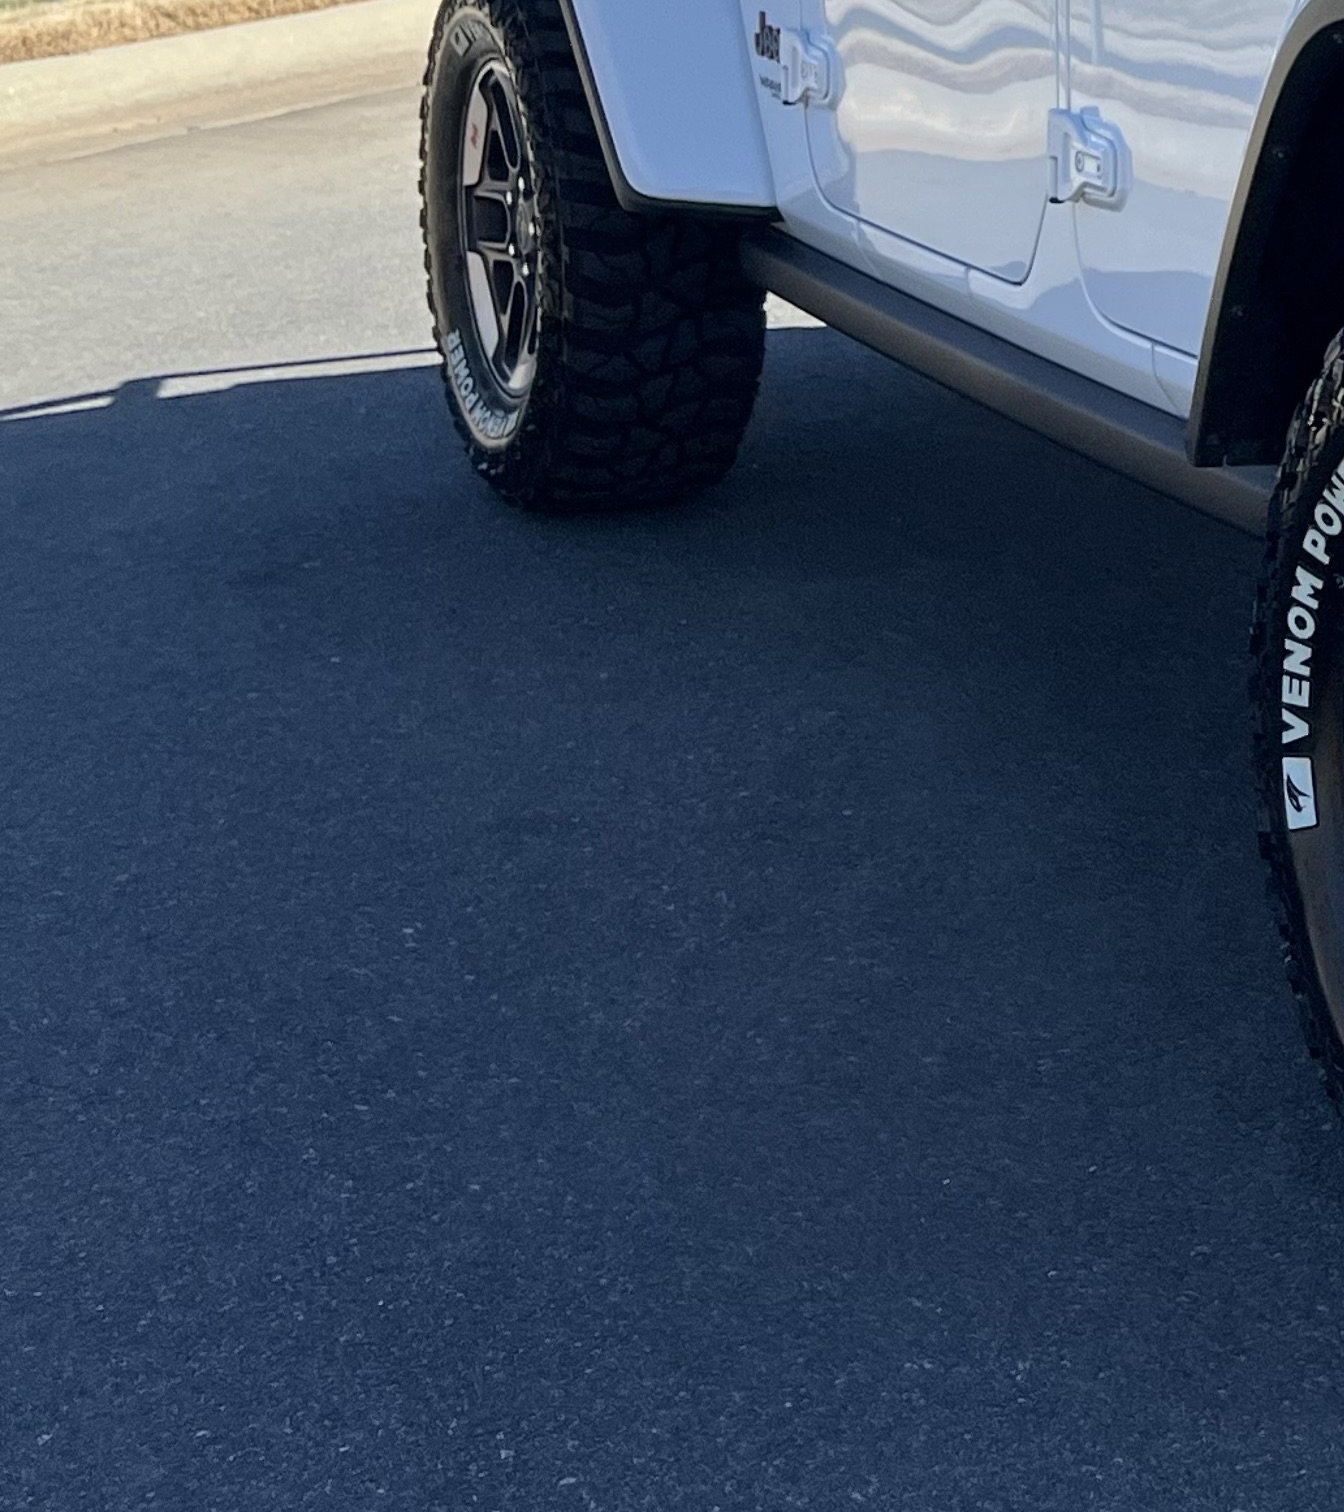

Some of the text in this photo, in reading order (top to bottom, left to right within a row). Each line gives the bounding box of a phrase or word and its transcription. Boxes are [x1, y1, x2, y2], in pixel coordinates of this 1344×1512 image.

[755, 11, 781, 64] Jee
[446, 329, 480, 411] POWER
[1281, 565, 1324, 745] VENOM
